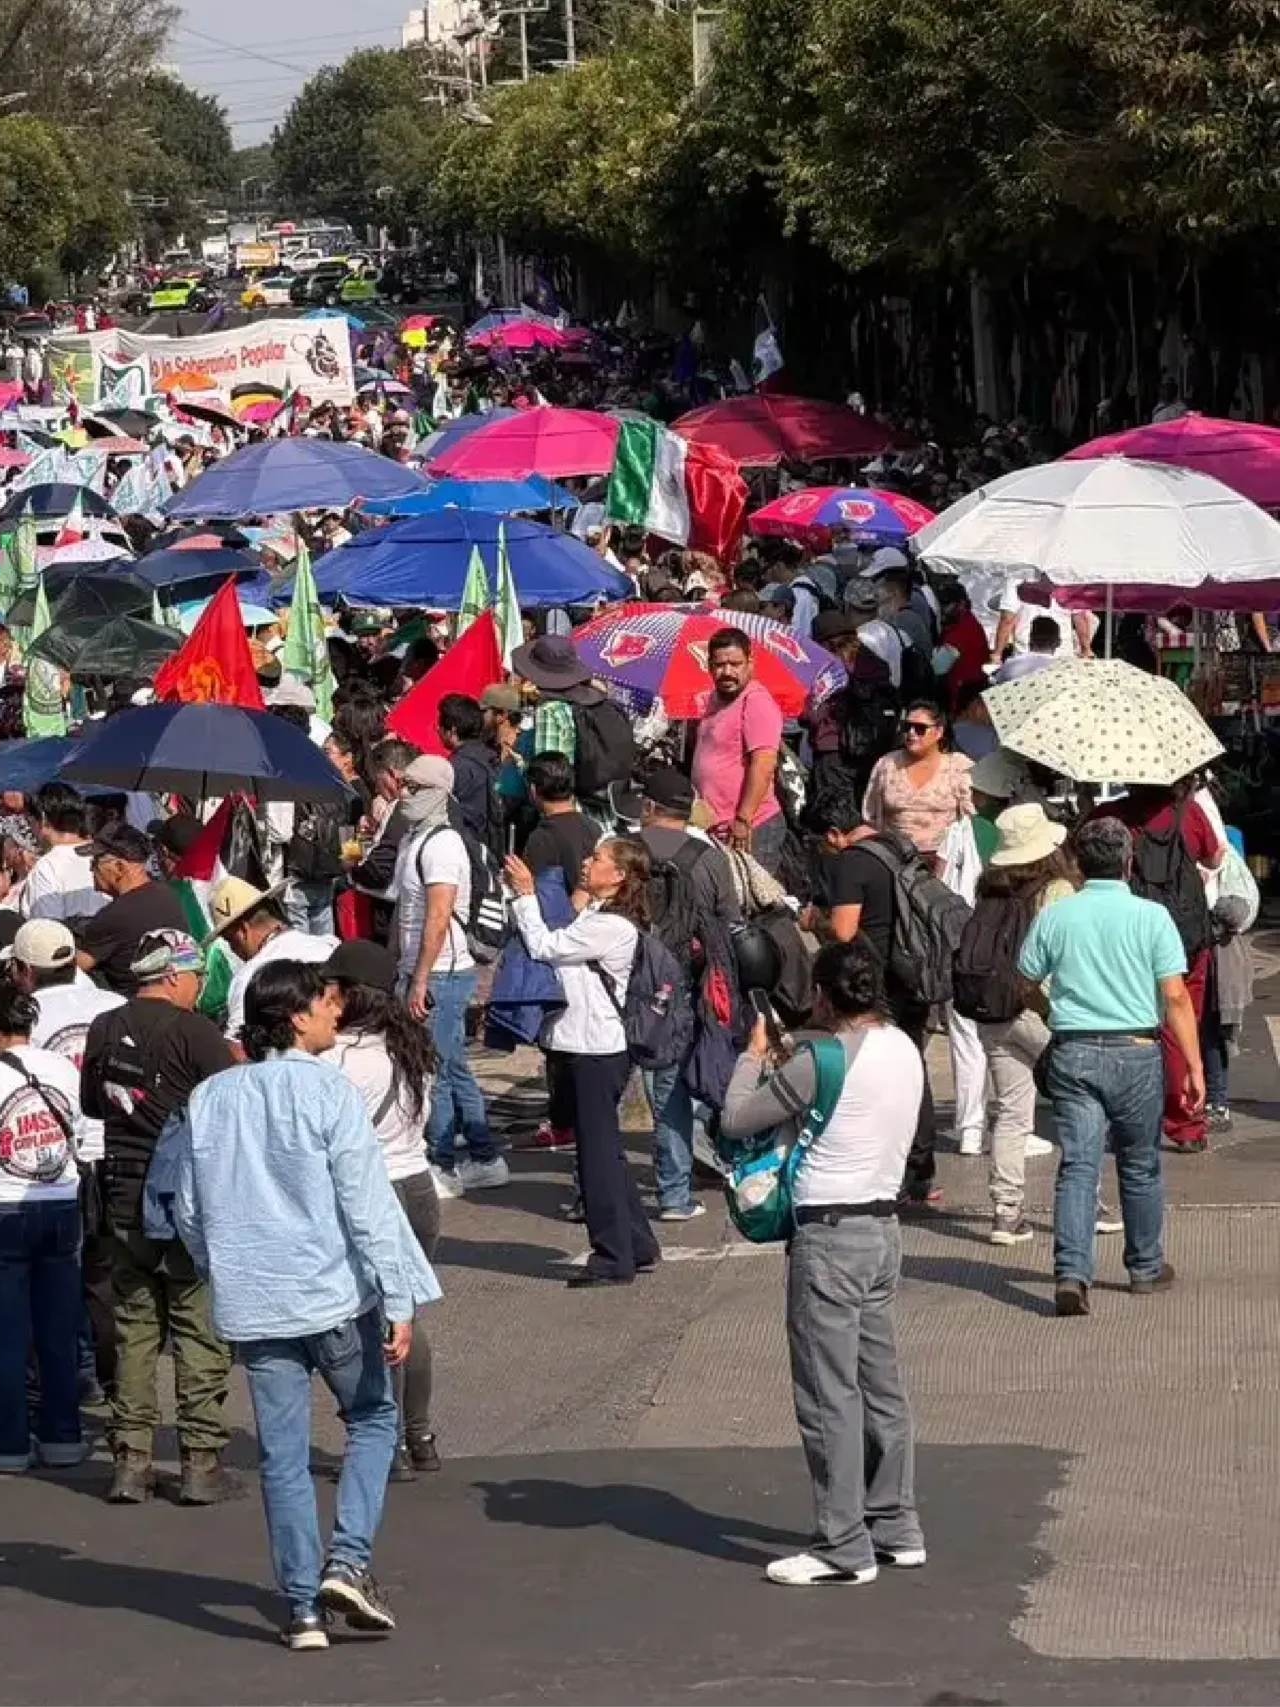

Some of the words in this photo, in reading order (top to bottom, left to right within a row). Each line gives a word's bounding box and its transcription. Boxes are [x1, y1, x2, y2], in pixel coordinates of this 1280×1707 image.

[174, 349, 238, 375] Soberanía
[241, 341, 287, 369] Popular
[14, 1132, 64, 1151] COPLAMA
